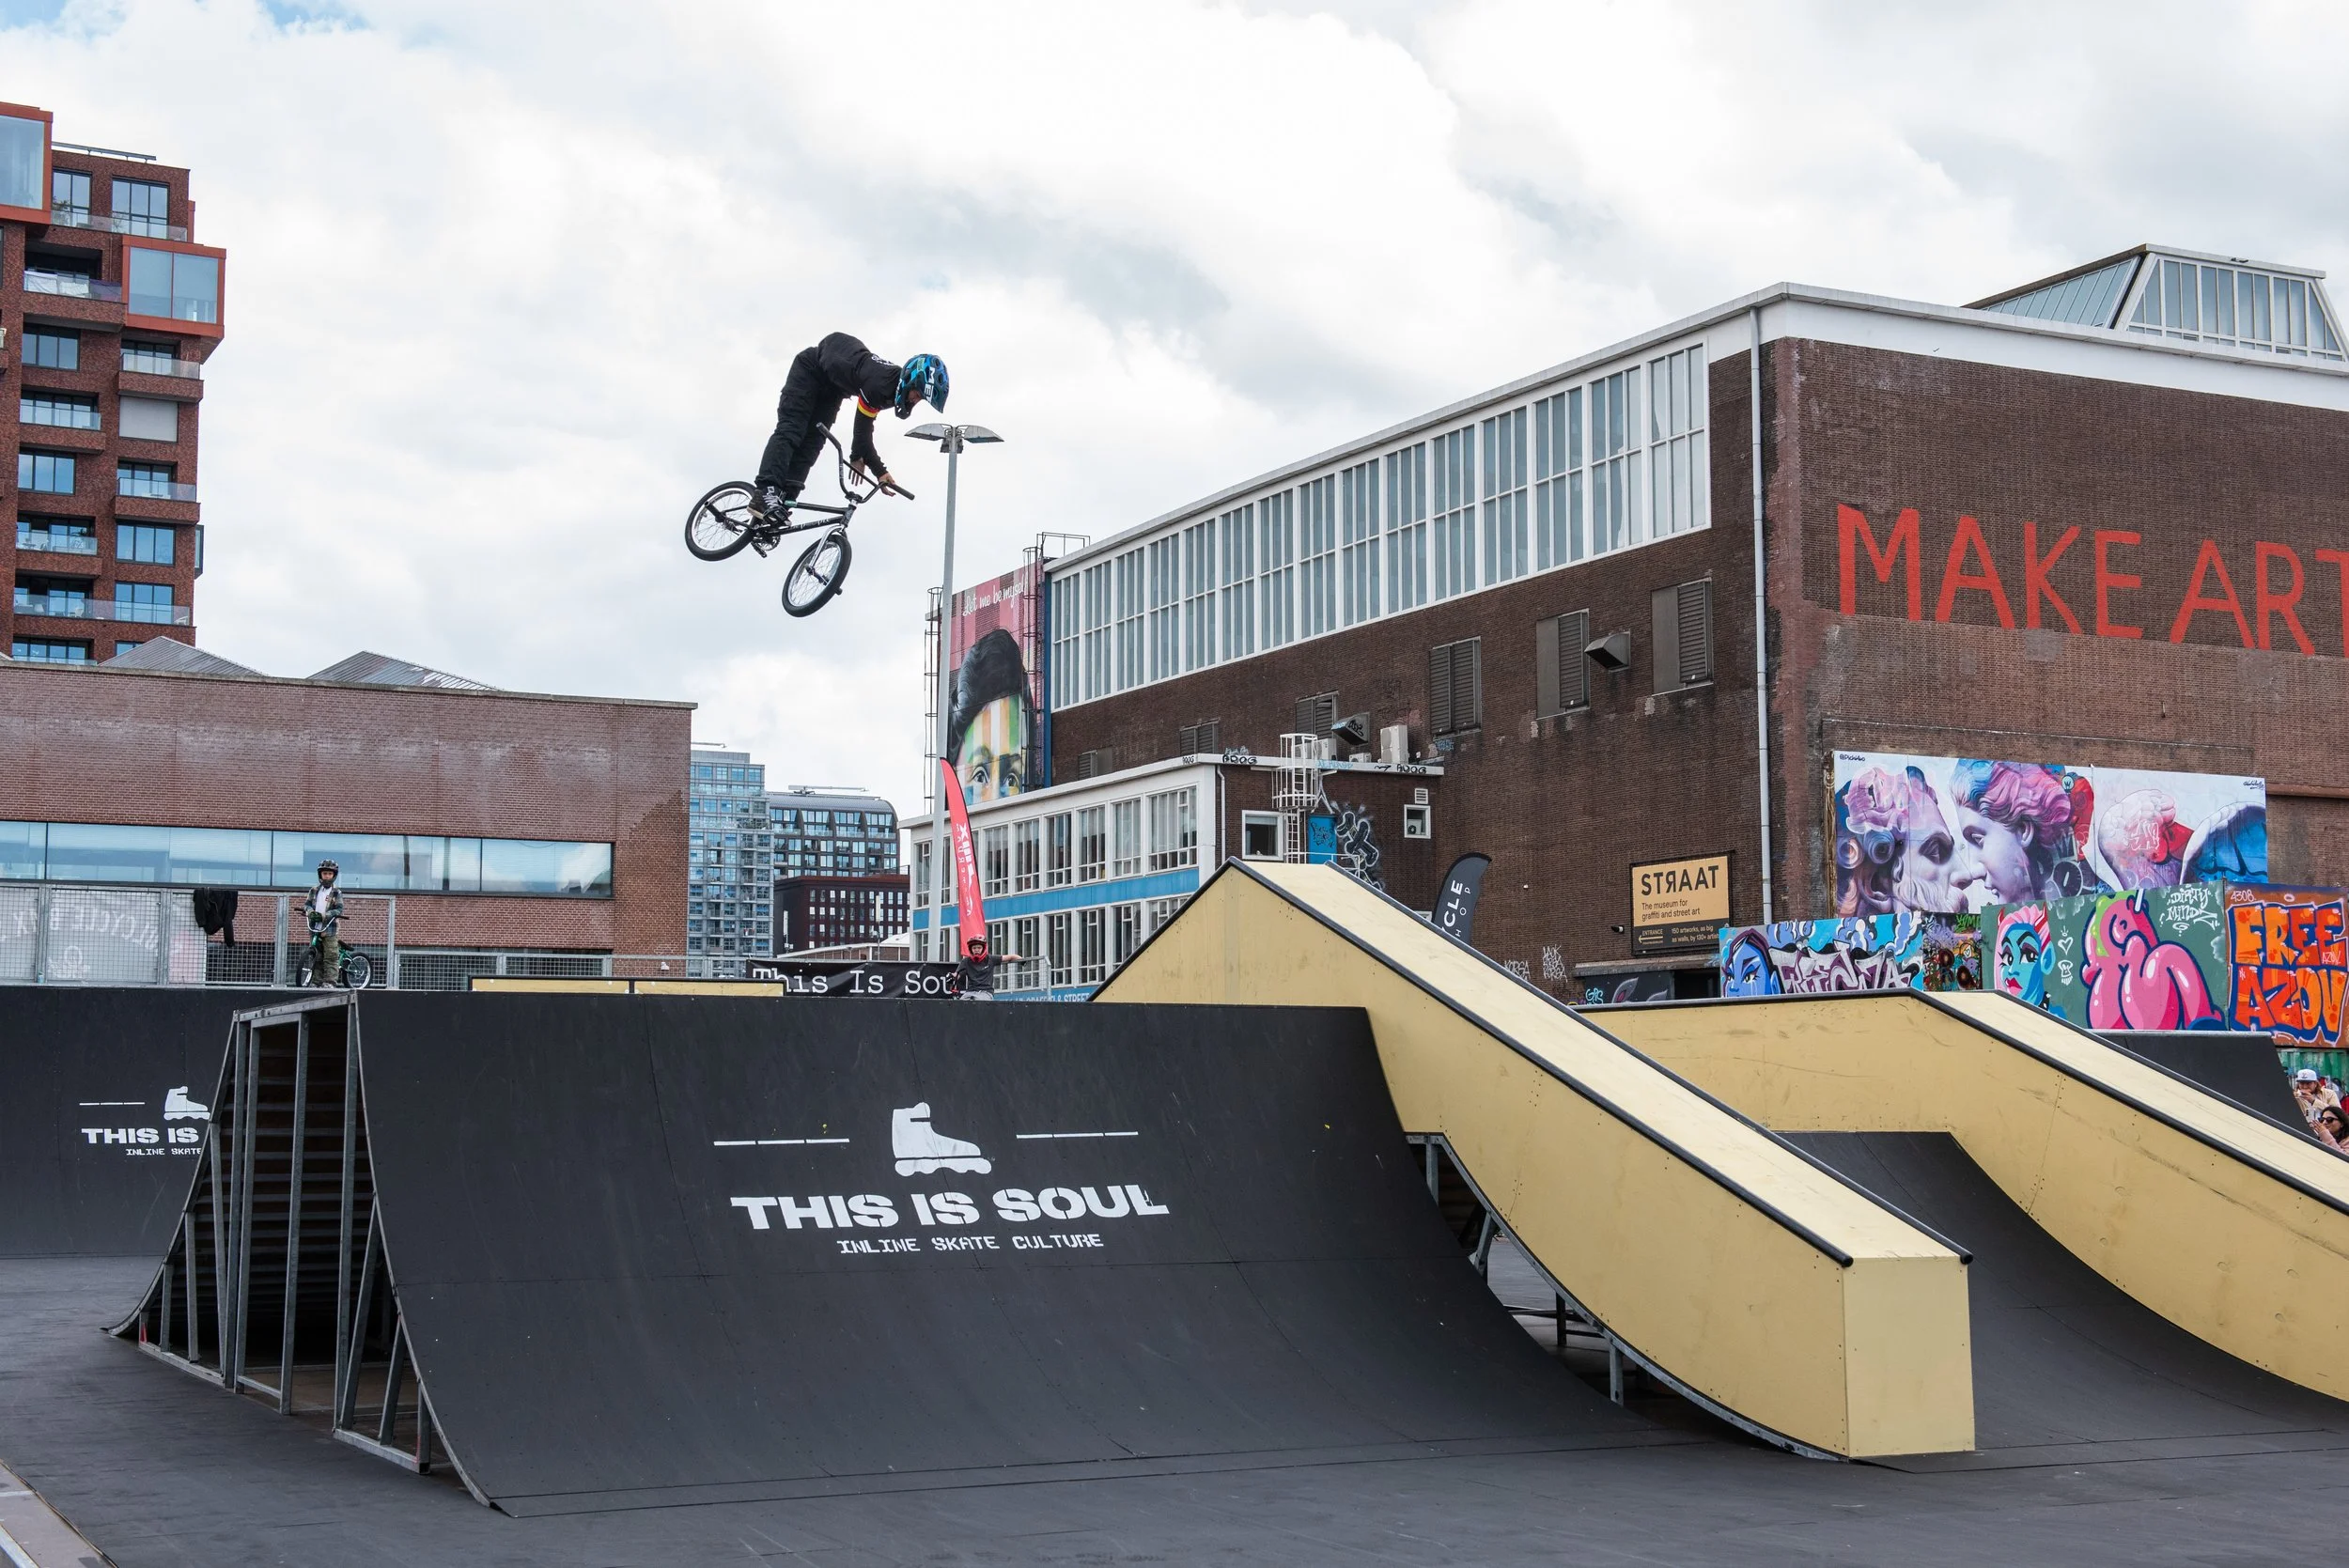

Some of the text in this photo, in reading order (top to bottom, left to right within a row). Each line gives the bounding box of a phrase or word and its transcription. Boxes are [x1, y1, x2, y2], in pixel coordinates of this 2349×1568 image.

[963, 570, 1029, 616] Let me be myself
[1838, 504, 2349, 658] MAKE ART
[1441, 879, 1463, 932] CLE
[1641, 898, 1688, 910] The museum for
[1641, 910, 1660, 922] graffiti
[1660, 909, 1672, 918] and
[1672, 908, 1690, 918] street
[1641, 928, 1663, 937] ENTRANCE
[2233, 906, 2347, 967] FREE
[753, 968, 829, 994] This
[848, 970, 884, 994] Is
[2234, 965, 2348, 1034] AZOV
[81, 1126, 200, 1144] THIS IS
[171, 1147, 202, 1156] SKATE
[730, 1184, 1170, 1230] THIS IS SOUL
[836, 1233, 1104, 1255] INLINE SKATE CULTURE
